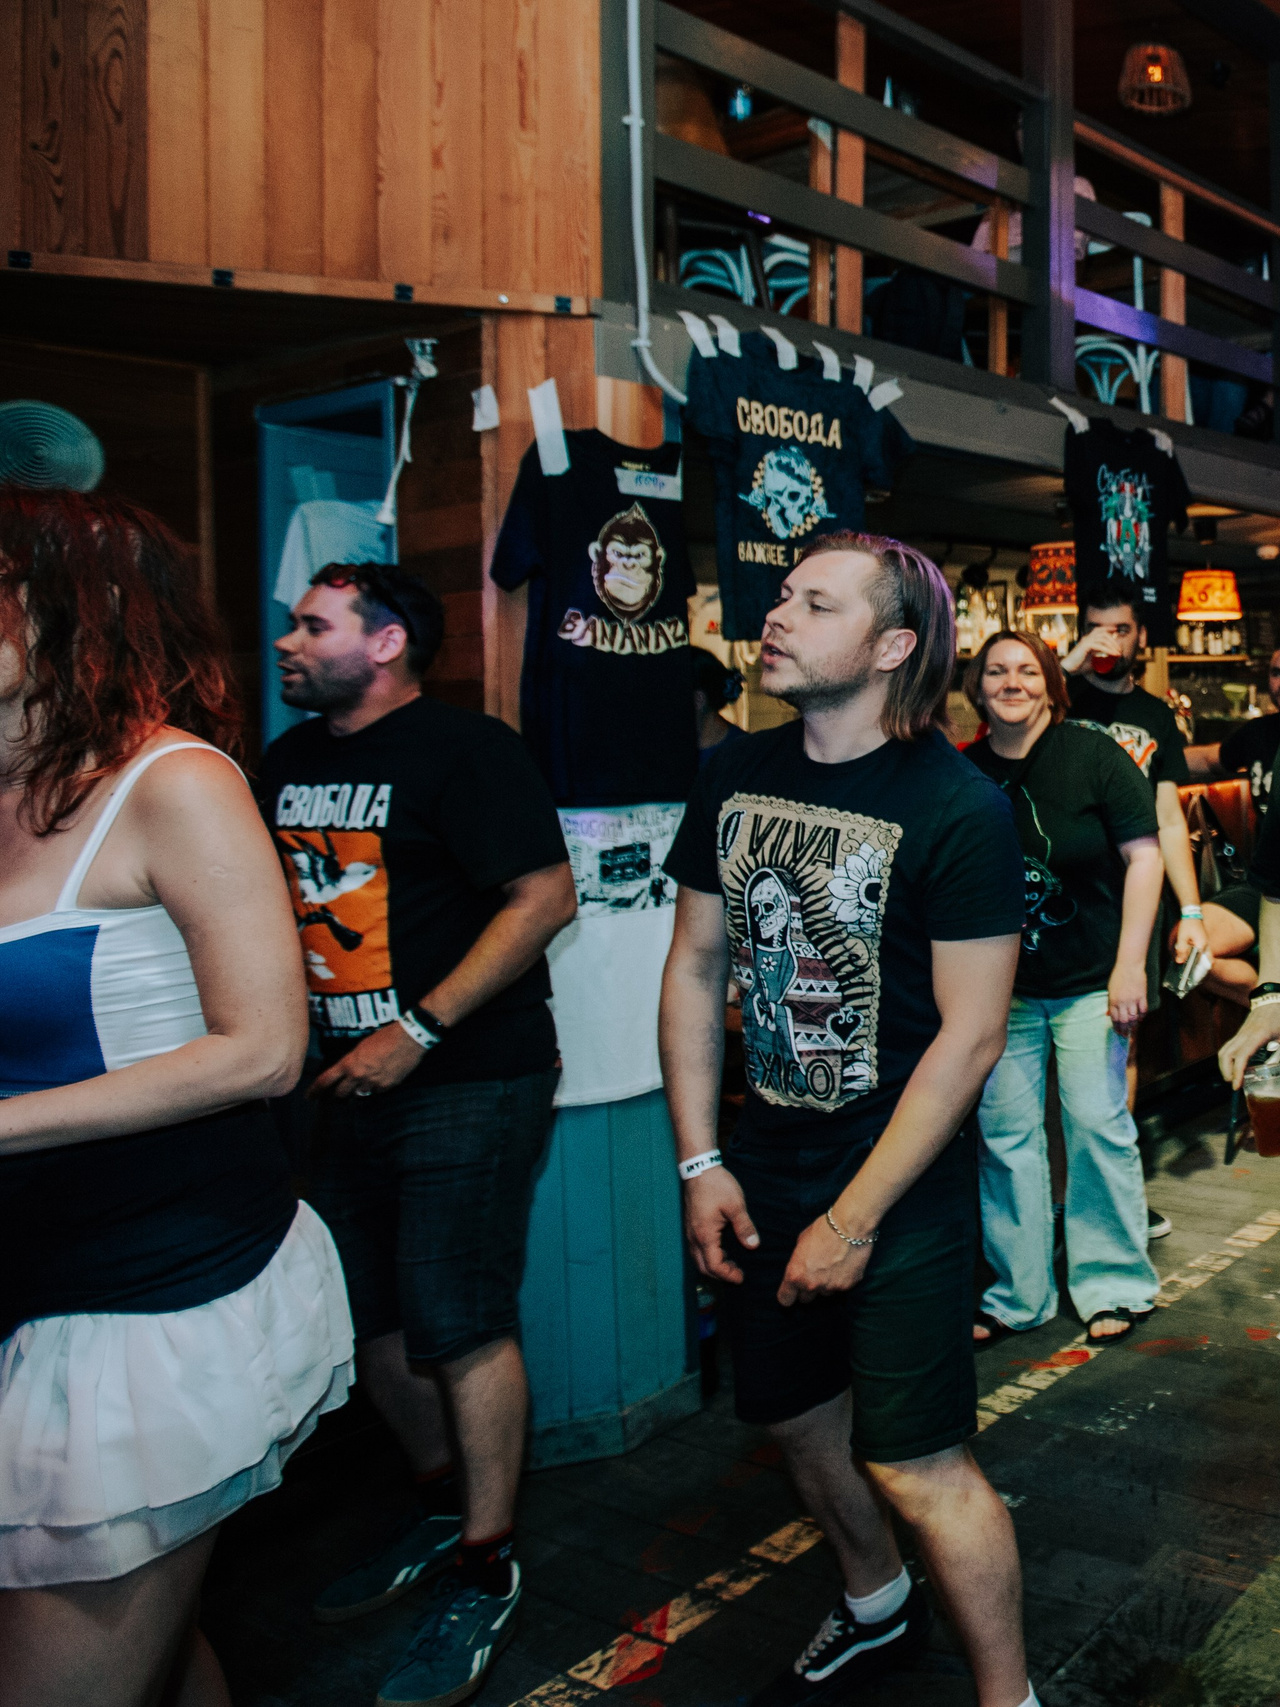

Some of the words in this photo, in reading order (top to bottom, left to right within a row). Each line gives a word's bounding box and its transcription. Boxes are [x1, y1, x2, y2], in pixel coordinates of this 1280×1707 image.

[736, 397, 843, 449] СВОБОДА
[557, 607, 688, 655] BANANAZ
[276, 783, 392, 830] СВОБОДА
[748, 814, 841, 871] VIVA
[325, 989, 400, 1029] МОДЫ
